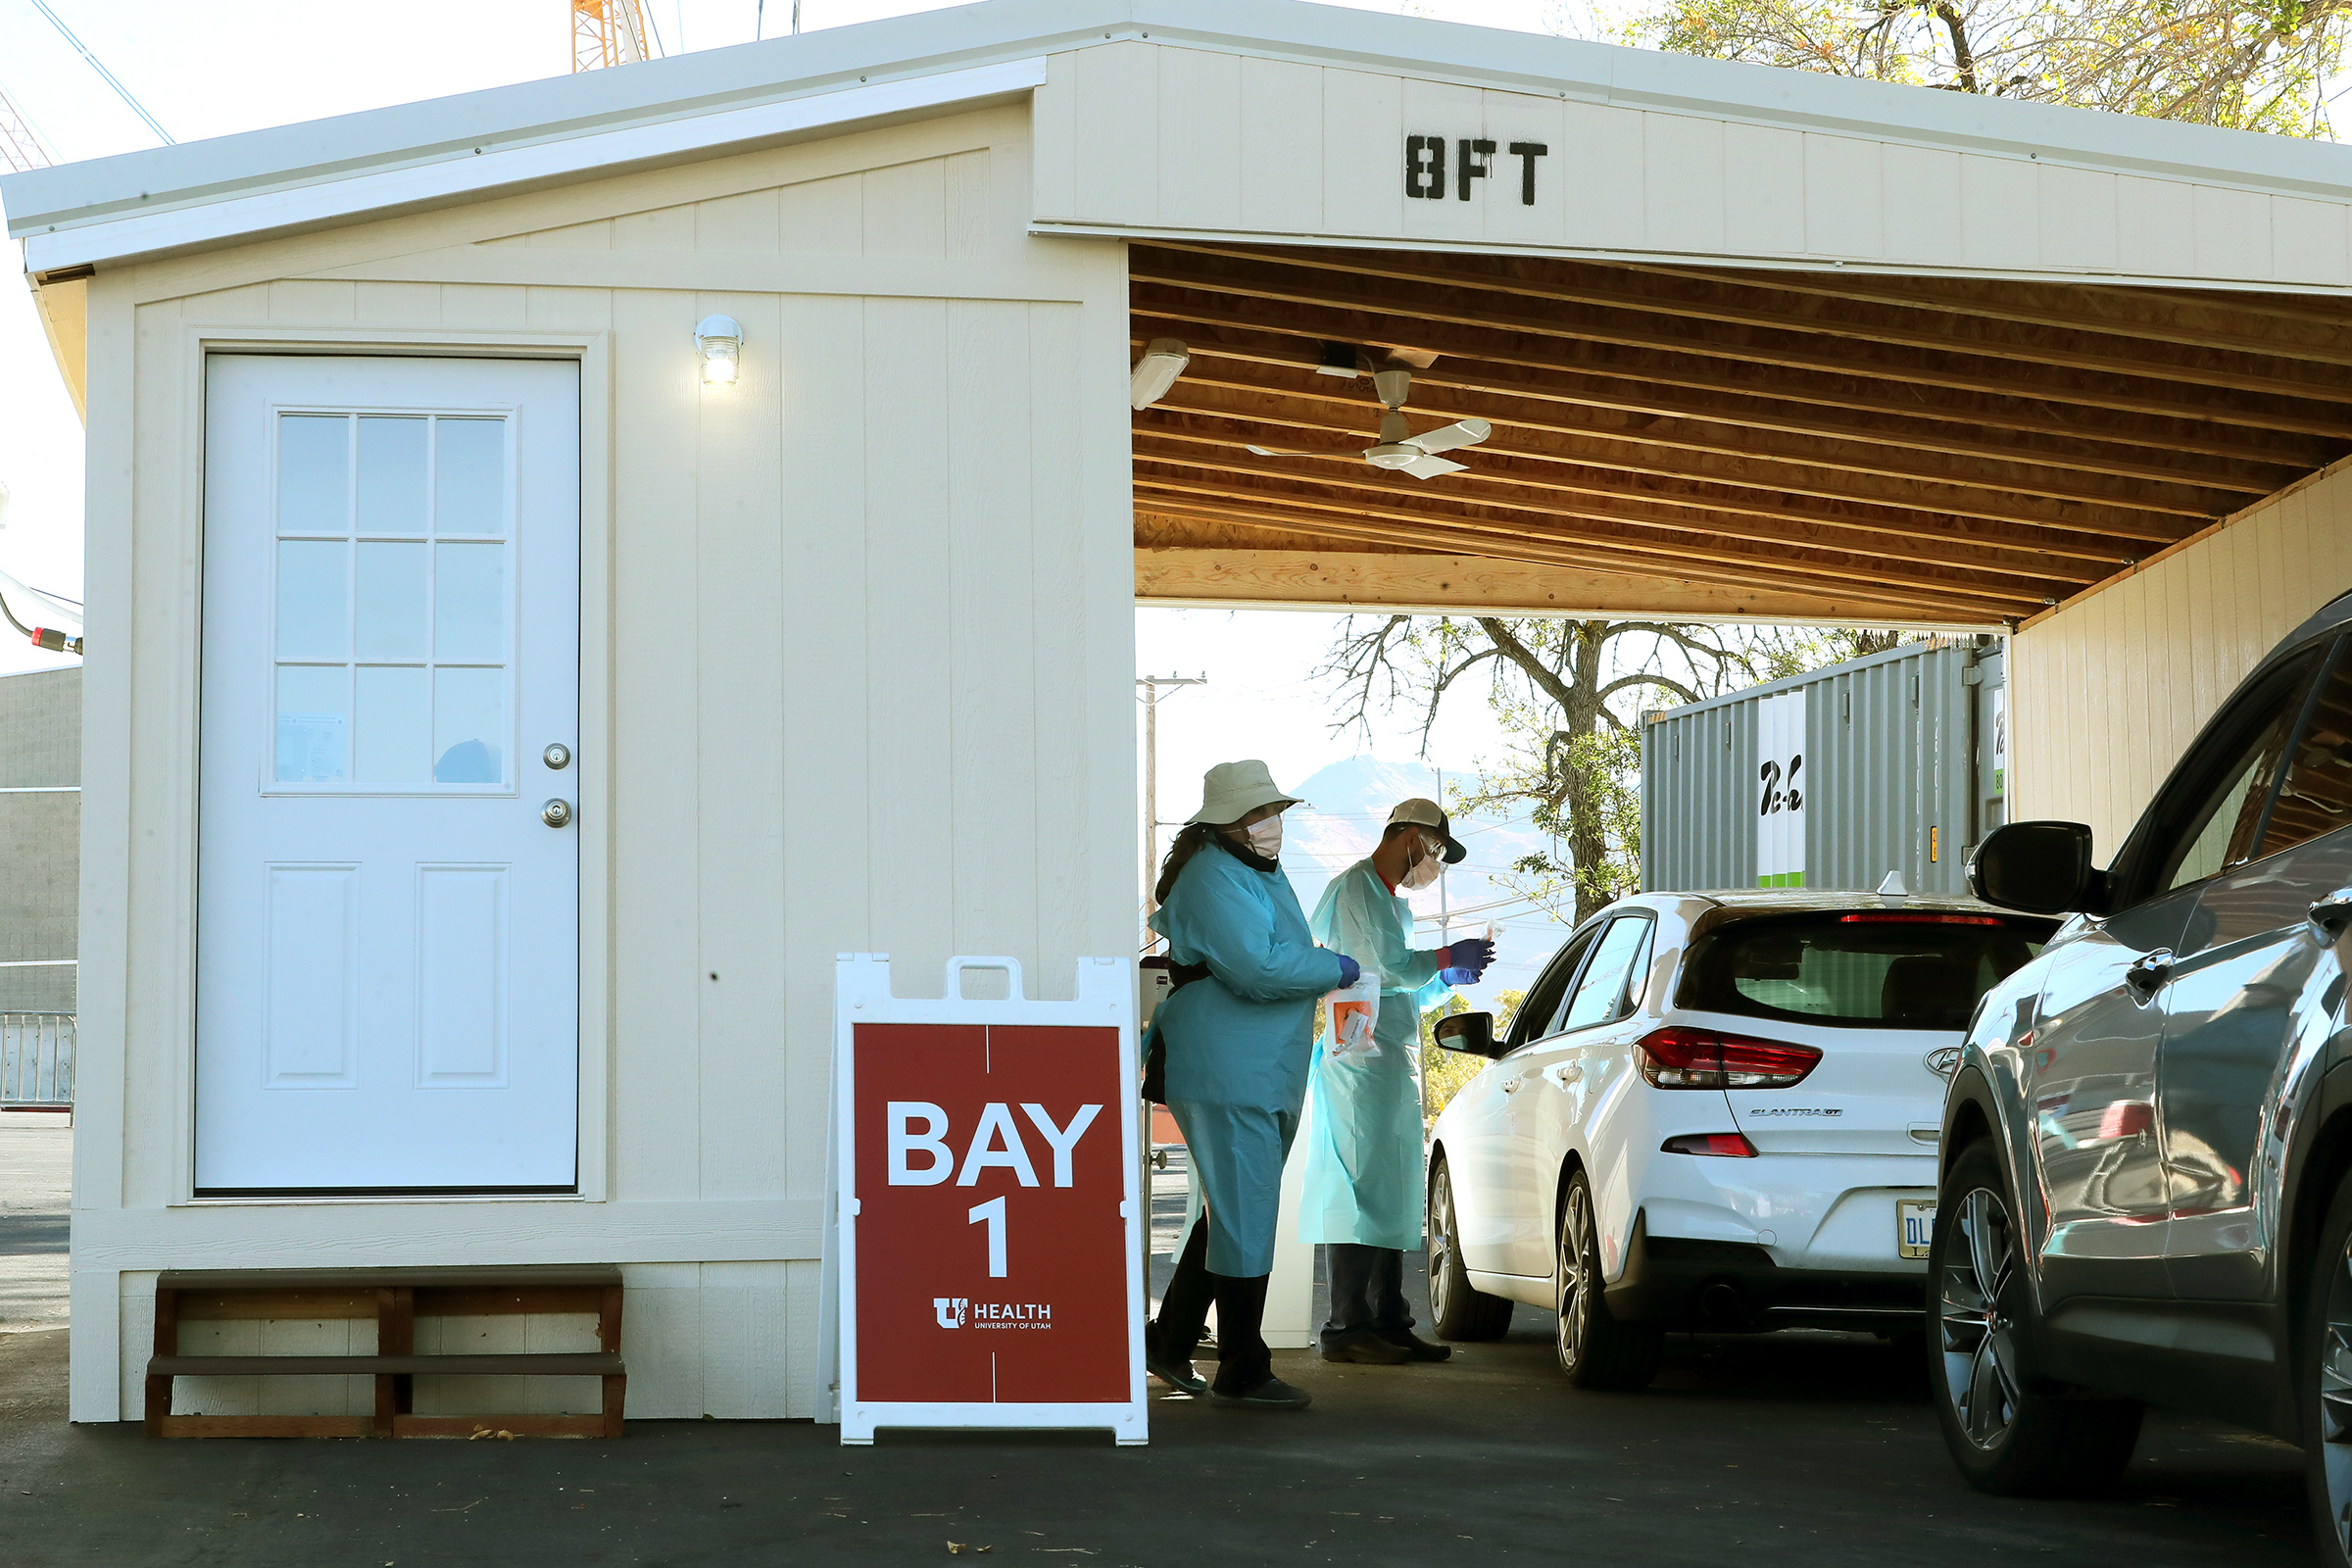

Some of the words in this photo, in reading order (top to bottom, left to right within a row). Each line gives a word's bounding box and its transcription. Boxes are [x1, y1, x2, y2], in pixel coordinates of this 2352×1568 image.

[1749, 1108, 1823, 1117] ELANTRA
[887, 1101, 1103, 1188] BAY
[968, 1195, 1007, 1279] 1
[974, 1303, 1052, 1320] HEALTH
